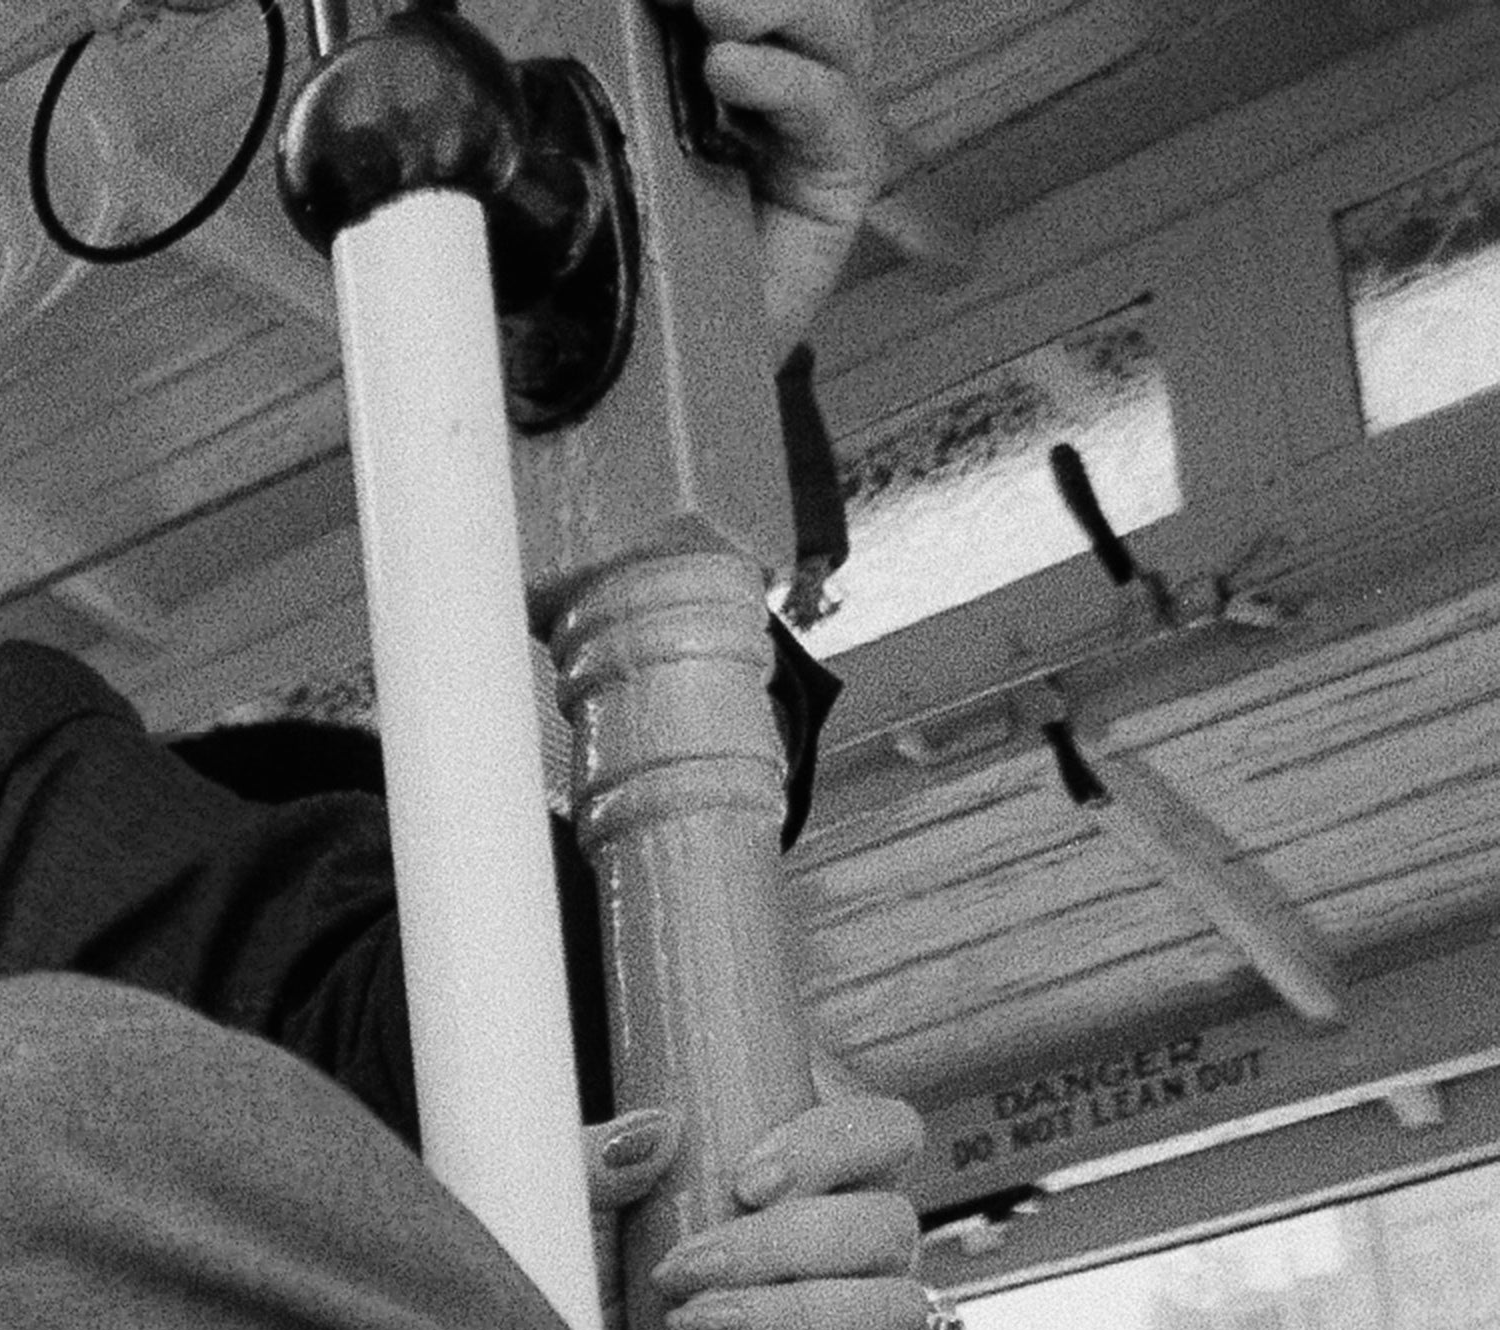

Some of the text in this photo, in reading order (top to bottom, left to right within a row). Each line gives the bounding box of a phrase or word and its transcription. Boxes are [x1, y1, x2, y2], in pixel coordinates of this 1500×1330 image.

[952, 1047, 1267, 1170] DO NOT LEAN OUT
[996, 1036, 1204, 1121] DANGER
